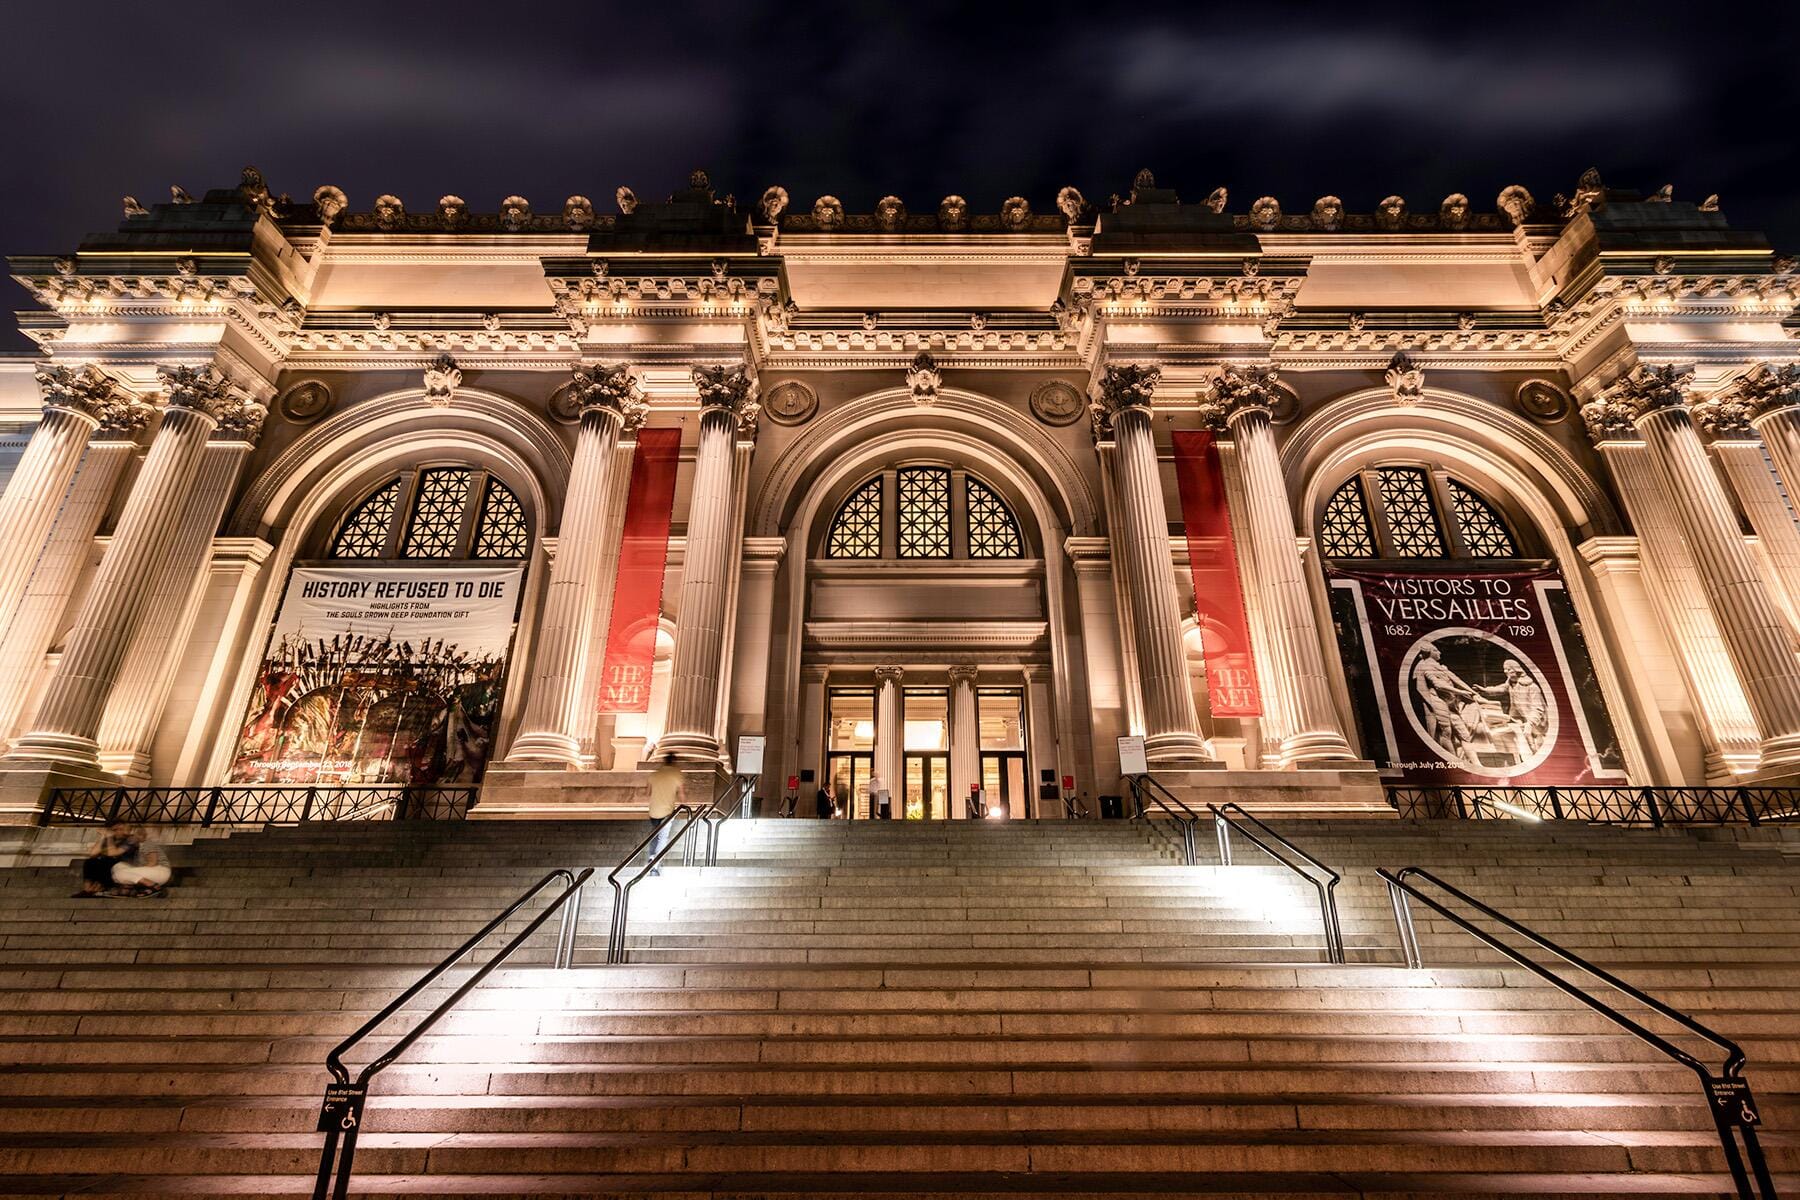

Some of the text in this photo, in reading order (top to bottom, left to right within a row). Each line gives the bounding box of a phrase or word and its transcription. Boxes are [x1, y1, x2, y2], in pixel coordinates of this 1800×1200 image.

[302, 581, 506, 598] HISTORY REFUSED TO DIE
[1384, 579, 1511, 596] VISITORS TO
[369, 602, 431, 610] HIGHLIGHTS FROM
[1376, 598, 1532, 621] VERSAILLES
[1384, 624, 1413, 636] 1682
[1508, 625, 1535, 637] 1789
[609, 664, 645, 684] THE
[1213, 668, 1251, 688] THE
[604, 684, 644, 704] MET
[1215, 688, 1254, 707] MET
[1385, 761, 1418, 770] Through
[1419, 761, 1434, 770] July
